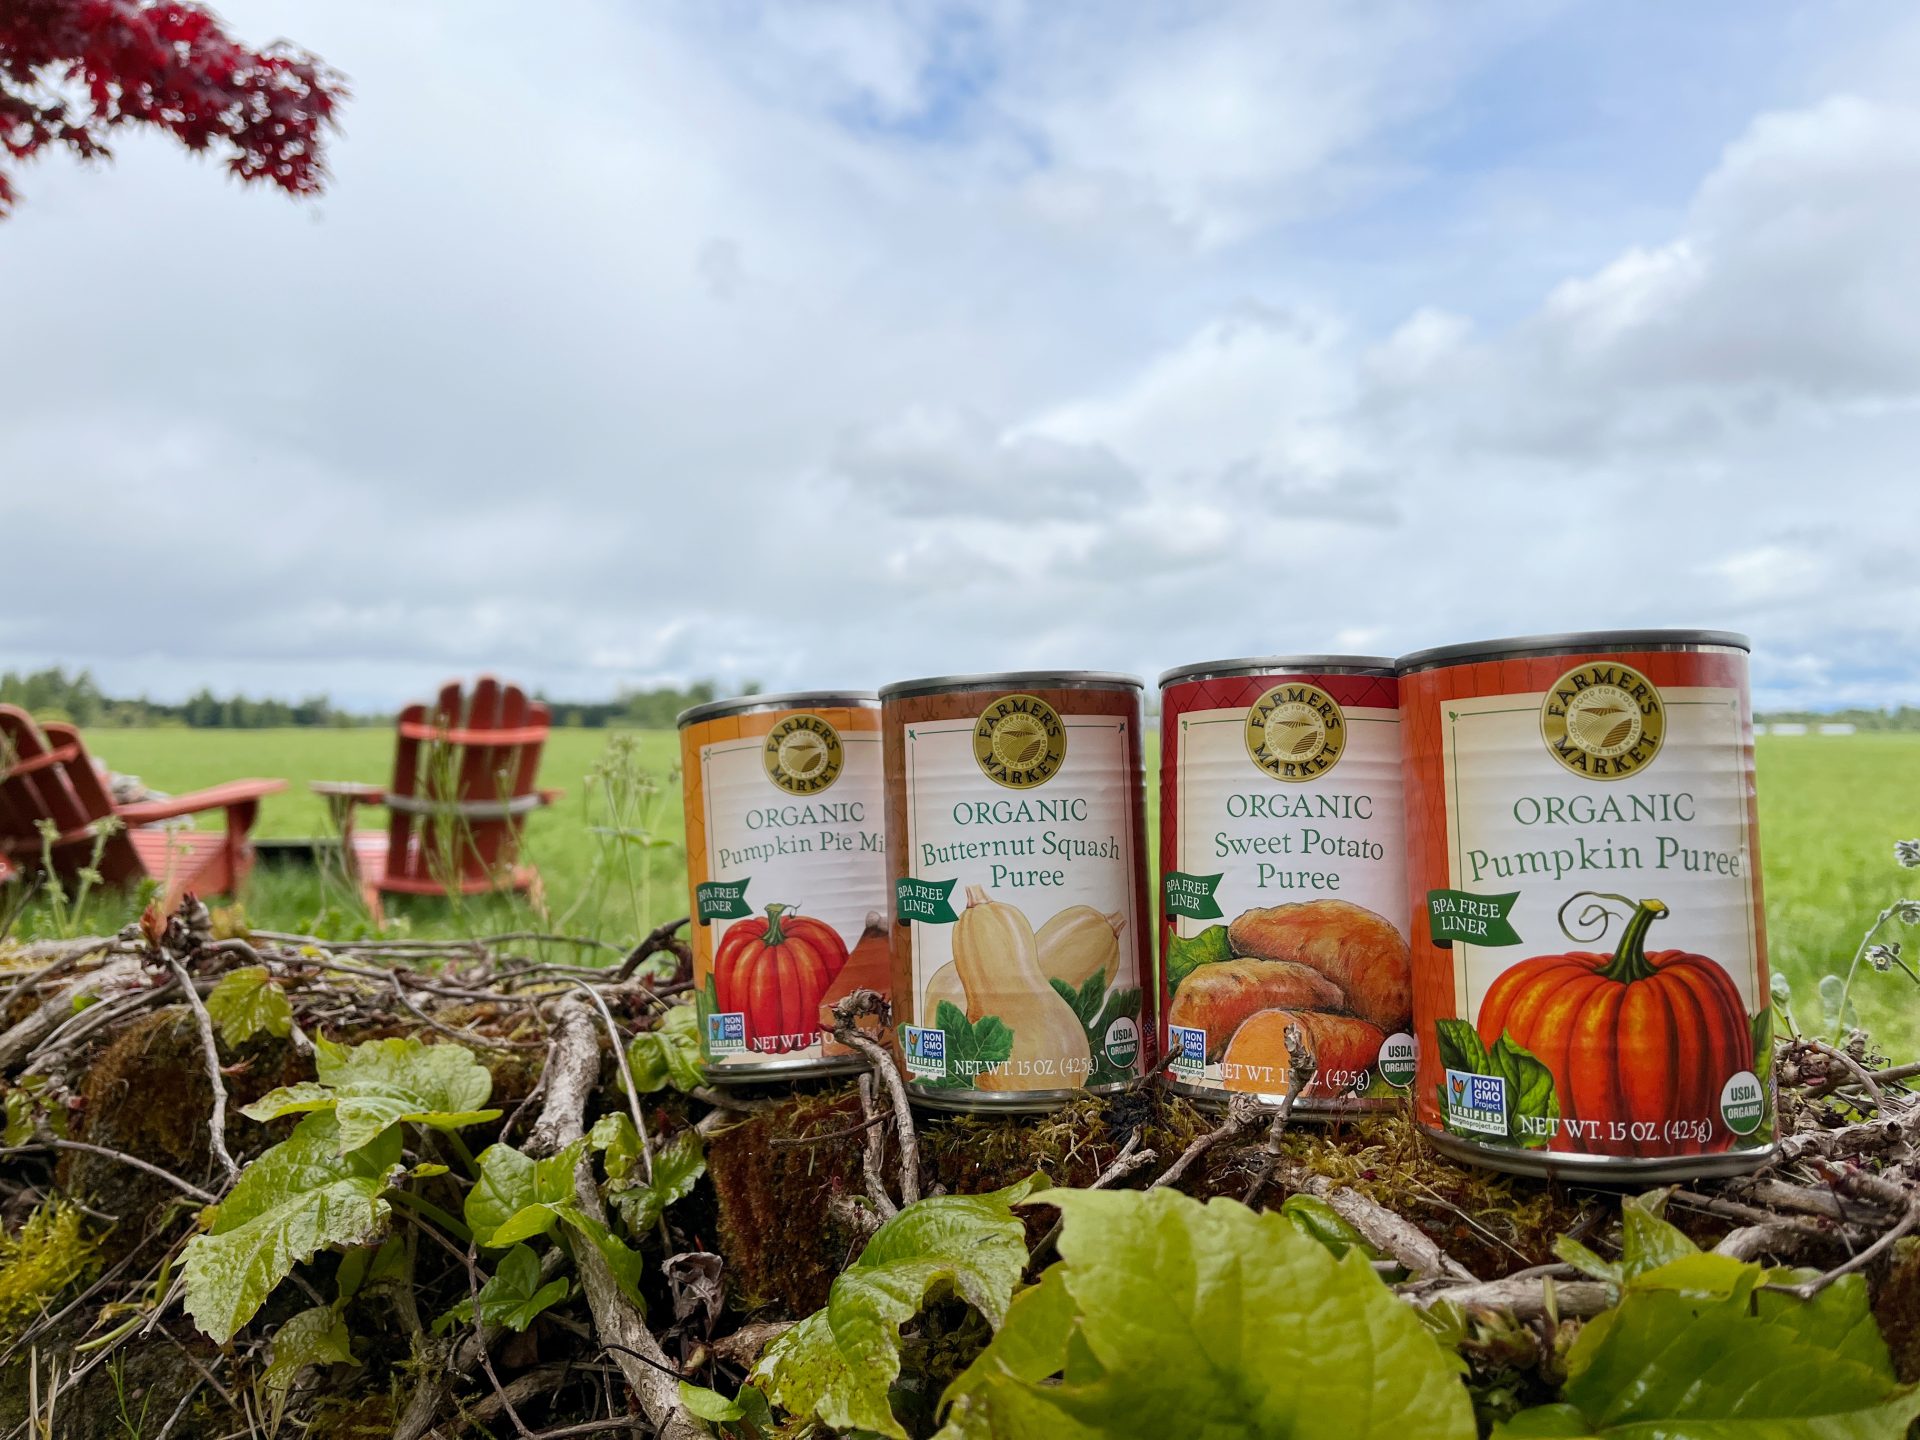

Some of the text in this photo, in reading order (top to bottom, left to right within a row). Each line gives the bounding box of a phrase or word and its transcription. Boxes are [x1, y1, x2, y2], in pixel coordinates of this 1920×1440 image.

[1548, 667, 1659, 717] FARMER'S
[1573, 690, 1595, 709] GOOD
[1620, 693, 1634, 708] YOU
[1252, 688, 1341, 729] FARMER'S
[1307, 709, 1320, 722] YOU
[979, 699, 1061, 738] FARMER'S
[1031, 719, 1043, 731] YOU
[767, 718, 839, 752] FARMER'S
[1569, 719, 1640, 754] GOOD FOR THE WORLD
[1254, 742, 1337, 776] MARKET
[1553, 731, 1656, 774] MARKET
[771, 761, 838, 791] MARKET
[983, 750, 1058, 784] MARKET
[746, 802, 865, 830] ORGANIC
[953, 799, 1088, 825] ORGANIC
[1226, 794, 1373, 820] ORGANIC
[1513, 793, 1696, 825] ORGANIC
[719, 831, 886, 869] Pumpkin Pie Mi
[921, 831, 1120, 867] Butternut Squash
[1215, 828, 1384, 861] Sweet Potato
[1467, 836, 1740, 882] Pumpkin Puree
[991, 865, 1065, 888] Puree
[1257, 863, 1340, 890] Puree
[714, 887, 739, 899] FREE
[898, 884, 944, 900] BPA FREE
[1166, 879, 1209, 895] BPA FREE
[704, 900, 732, 912] LINER
[903, 900, 935, 915] LINER
[1171, 893, 1200, 910] LINER
[1432, 897, 1501, 919] BPA FREE
[1441, 916, 1488, 937] LINER
[725, 1016, 741, 1024] NON
[711, 1039, 742, 1047] VERIFIED
[753, 1036, 778, 1050] NET
[780, 1033, 806, 1049] WT.
[809, 1032, 820, 1044] 15
[924, 1032, 941, 1042] NON
[1113, 1028, 1132, 1041] USDA
[1185, 1031, 1202, 1042] NON
[924, 1041, 942, 1050] GMO
[924, 1049, 942, 1058] Project
[1111, 1043, 1136, 1055] ORGANIC
[1185, 1041, 1203, 1050] GMO
[1185, 1049, 1202, 1058] Project
[1388, 1045, 1412, 1057] USDA
[908, 1055, 942, 1067] VERIFIED
[954, 1056, 1098, 1076] NET WT. 15 OZ. (425g)
[1385, 1063, 1416, 1072] ORGANIC
[1214, 1062, 1243, 1079] NET
[1244, 1065, 1275, 1083] WT.
[1279, 1068, 1289, 1083] 1
[1325, 1068, 1370, 1091] (425g)
[1474, 1079, 1499, 1091] NON
[1474, 1089, 1501, 1102] GMO
[1731, 1085, 1756, 1101] USDA
[1474, 1099, 1501, 1110] Project
[1728, 1104, 1760, 1119] ORGANIC
[1451, 1105, 1502, 1123] VERIFIED
[1519, 1115, 1712, 1144] NET WT. 15 OZ. (425g)
